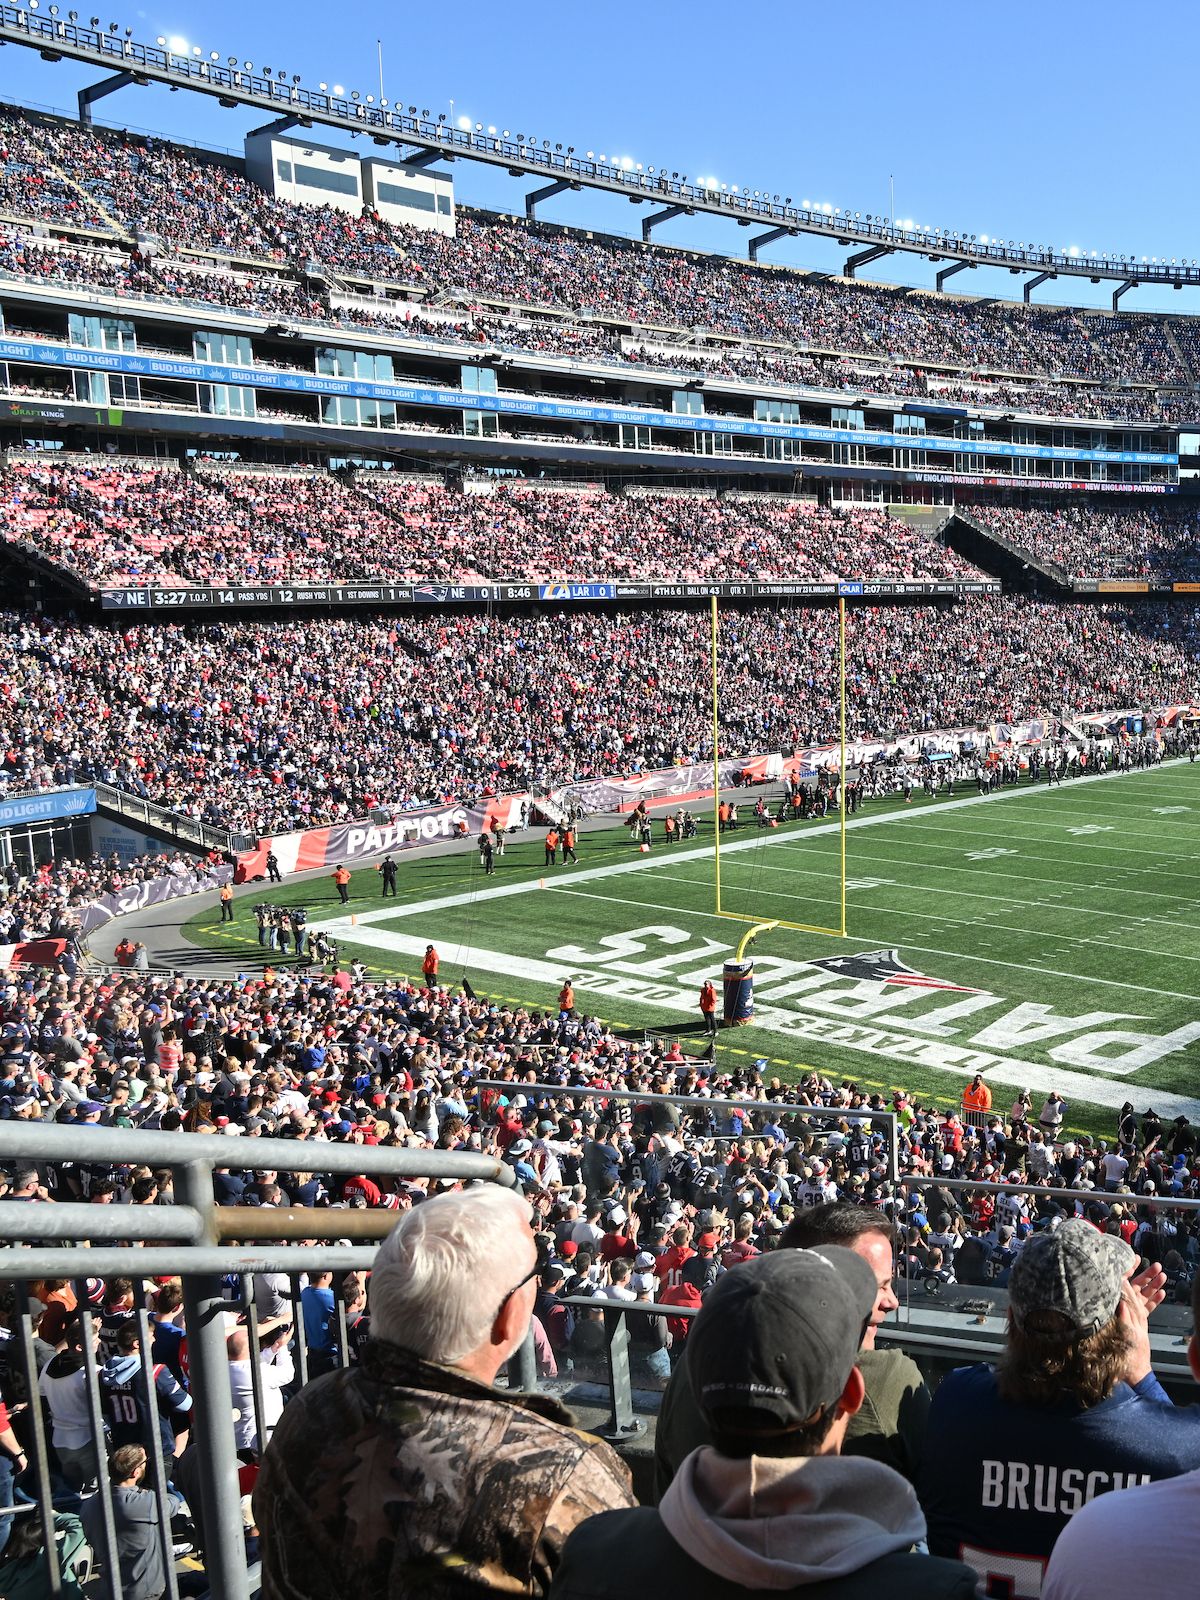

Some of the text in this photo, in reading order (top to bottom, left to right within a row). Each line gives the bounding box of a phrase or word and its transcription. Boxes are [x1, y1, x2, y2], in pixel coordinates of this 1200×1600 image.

[65, 352, 119, 366] BUD LIGHT
[152, 363, 201, 375] BUD LIGHT
[231, 372, 277, 384] BUD LIGHT
[306, 379, 349, 391] BUD LIGHT
[392, 390, 415, 399] LIGHT
[12, 408, 64, 418] DRAFTKINGS
[924, 474, 953, 483] ENGLAND
[1042, 481, 1072, 489] PATRIOTS
[127, 593, 145, 604] NE
[155, 592, 186, 604] 3:27
[218, 592, 234, 603] 14
[279, 591, 293, 602] 12
[390, 589, 395, 600] 1
[451, 587, 605, 598] NE 0 8:46 LAR 0
[15, 801, 52, 816] LIGHT
[556, 972, 680, 1000] OF US
[779, 1017, 1003, 1072] IT TAKES
[617, 1107, 631, 1123] 12
[852, 1145, 870, 1161] 87
[667, 1158, 684, 1176] 54
[110, 1395, 137, 1423] 10
[982, 1460, 1151, 1516] BRUSC
